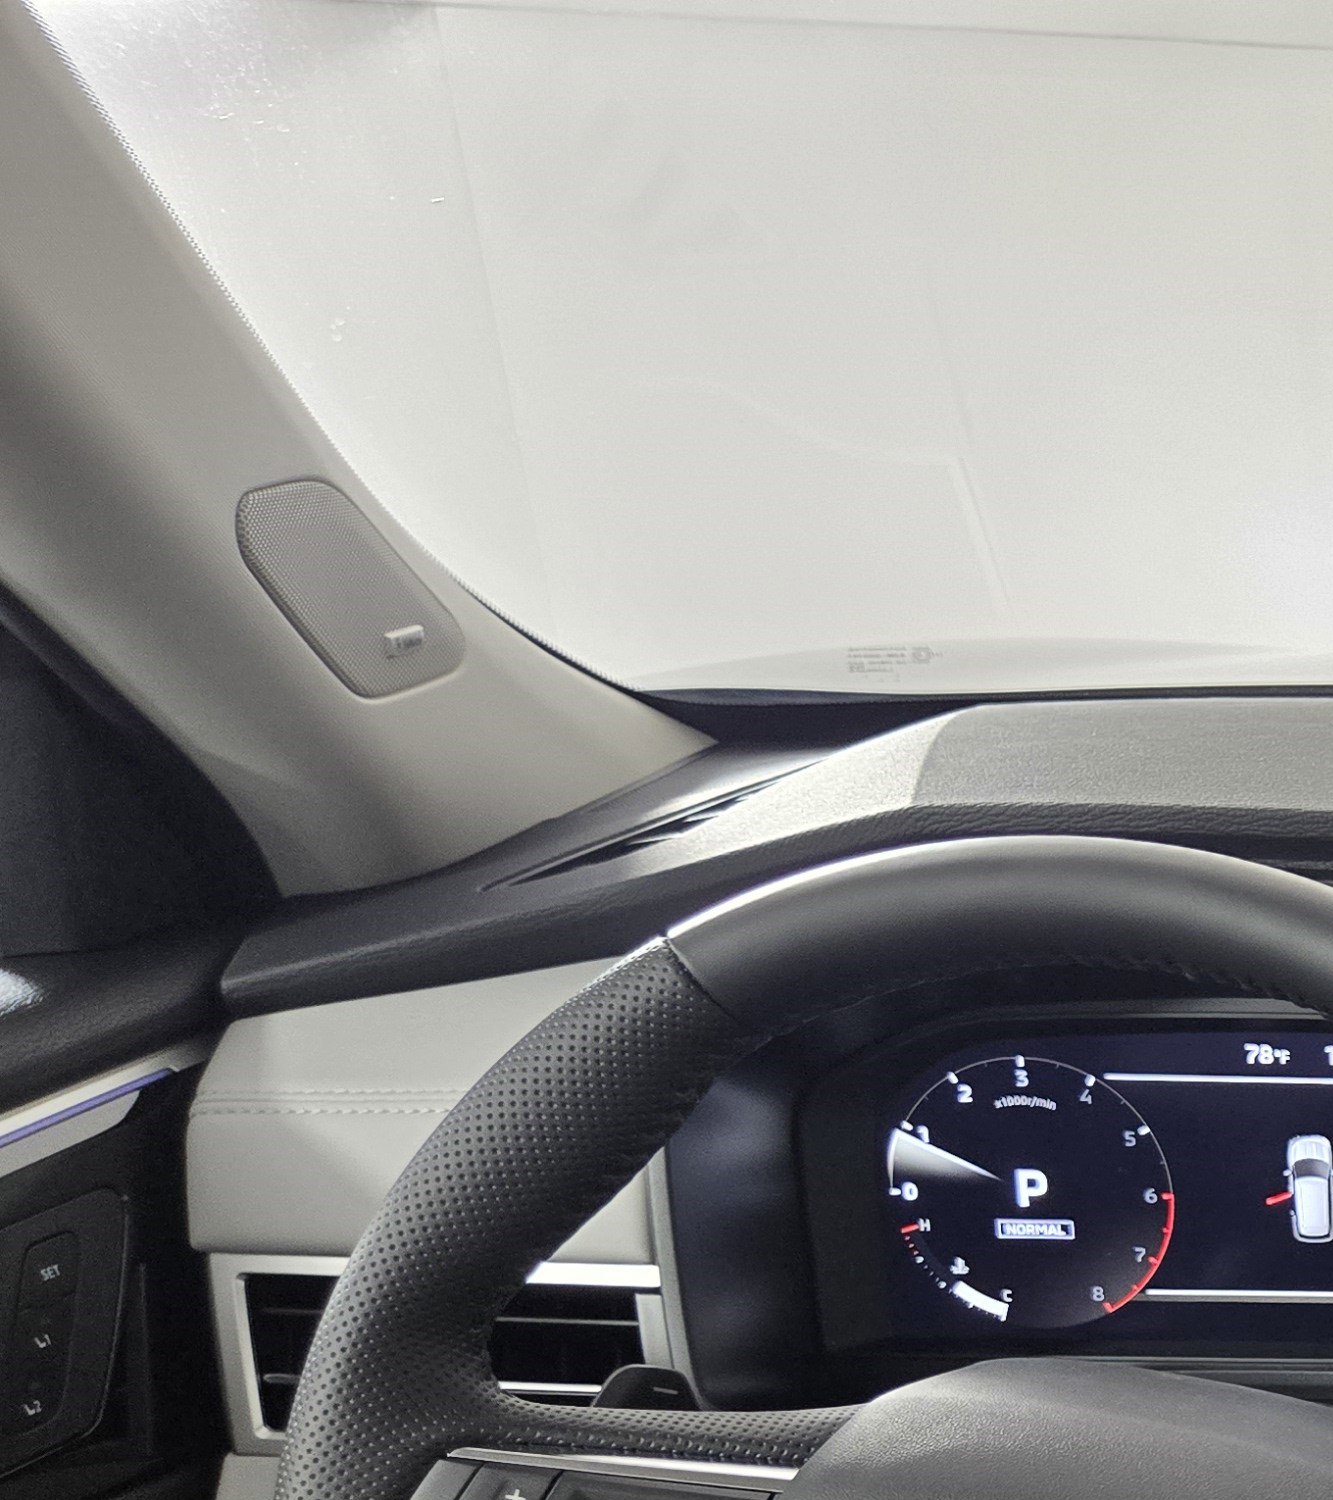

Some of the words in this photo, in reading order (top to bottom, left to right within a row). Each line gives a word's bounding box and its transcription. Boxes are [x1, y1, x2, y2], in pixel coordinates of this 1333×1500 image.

[1015, 1070, 1029, 1087] 3
[957, 1084, 973, 1103] 2
[1080, 1089, 1092, 1104] 4
[993, 1095, 1057, 1111] x1000r/min
[916, 1125, 930, 1143] 1
[1124, 1131, 1137, 1147] 5
[901, 1181, 919, 1201] 0
[1014, 1168, 1048, 1208] P
[1144, 1188, 1158, 1203] 6
[918, 1219, 931, 1232] H
[1004, 1223, 1067, 1236] NORMAL
[1134, 1247, 1146, 1262] 7
[40, 1263, 61, 1281] SET
[1091, 1286, 1105, 1301] 8
